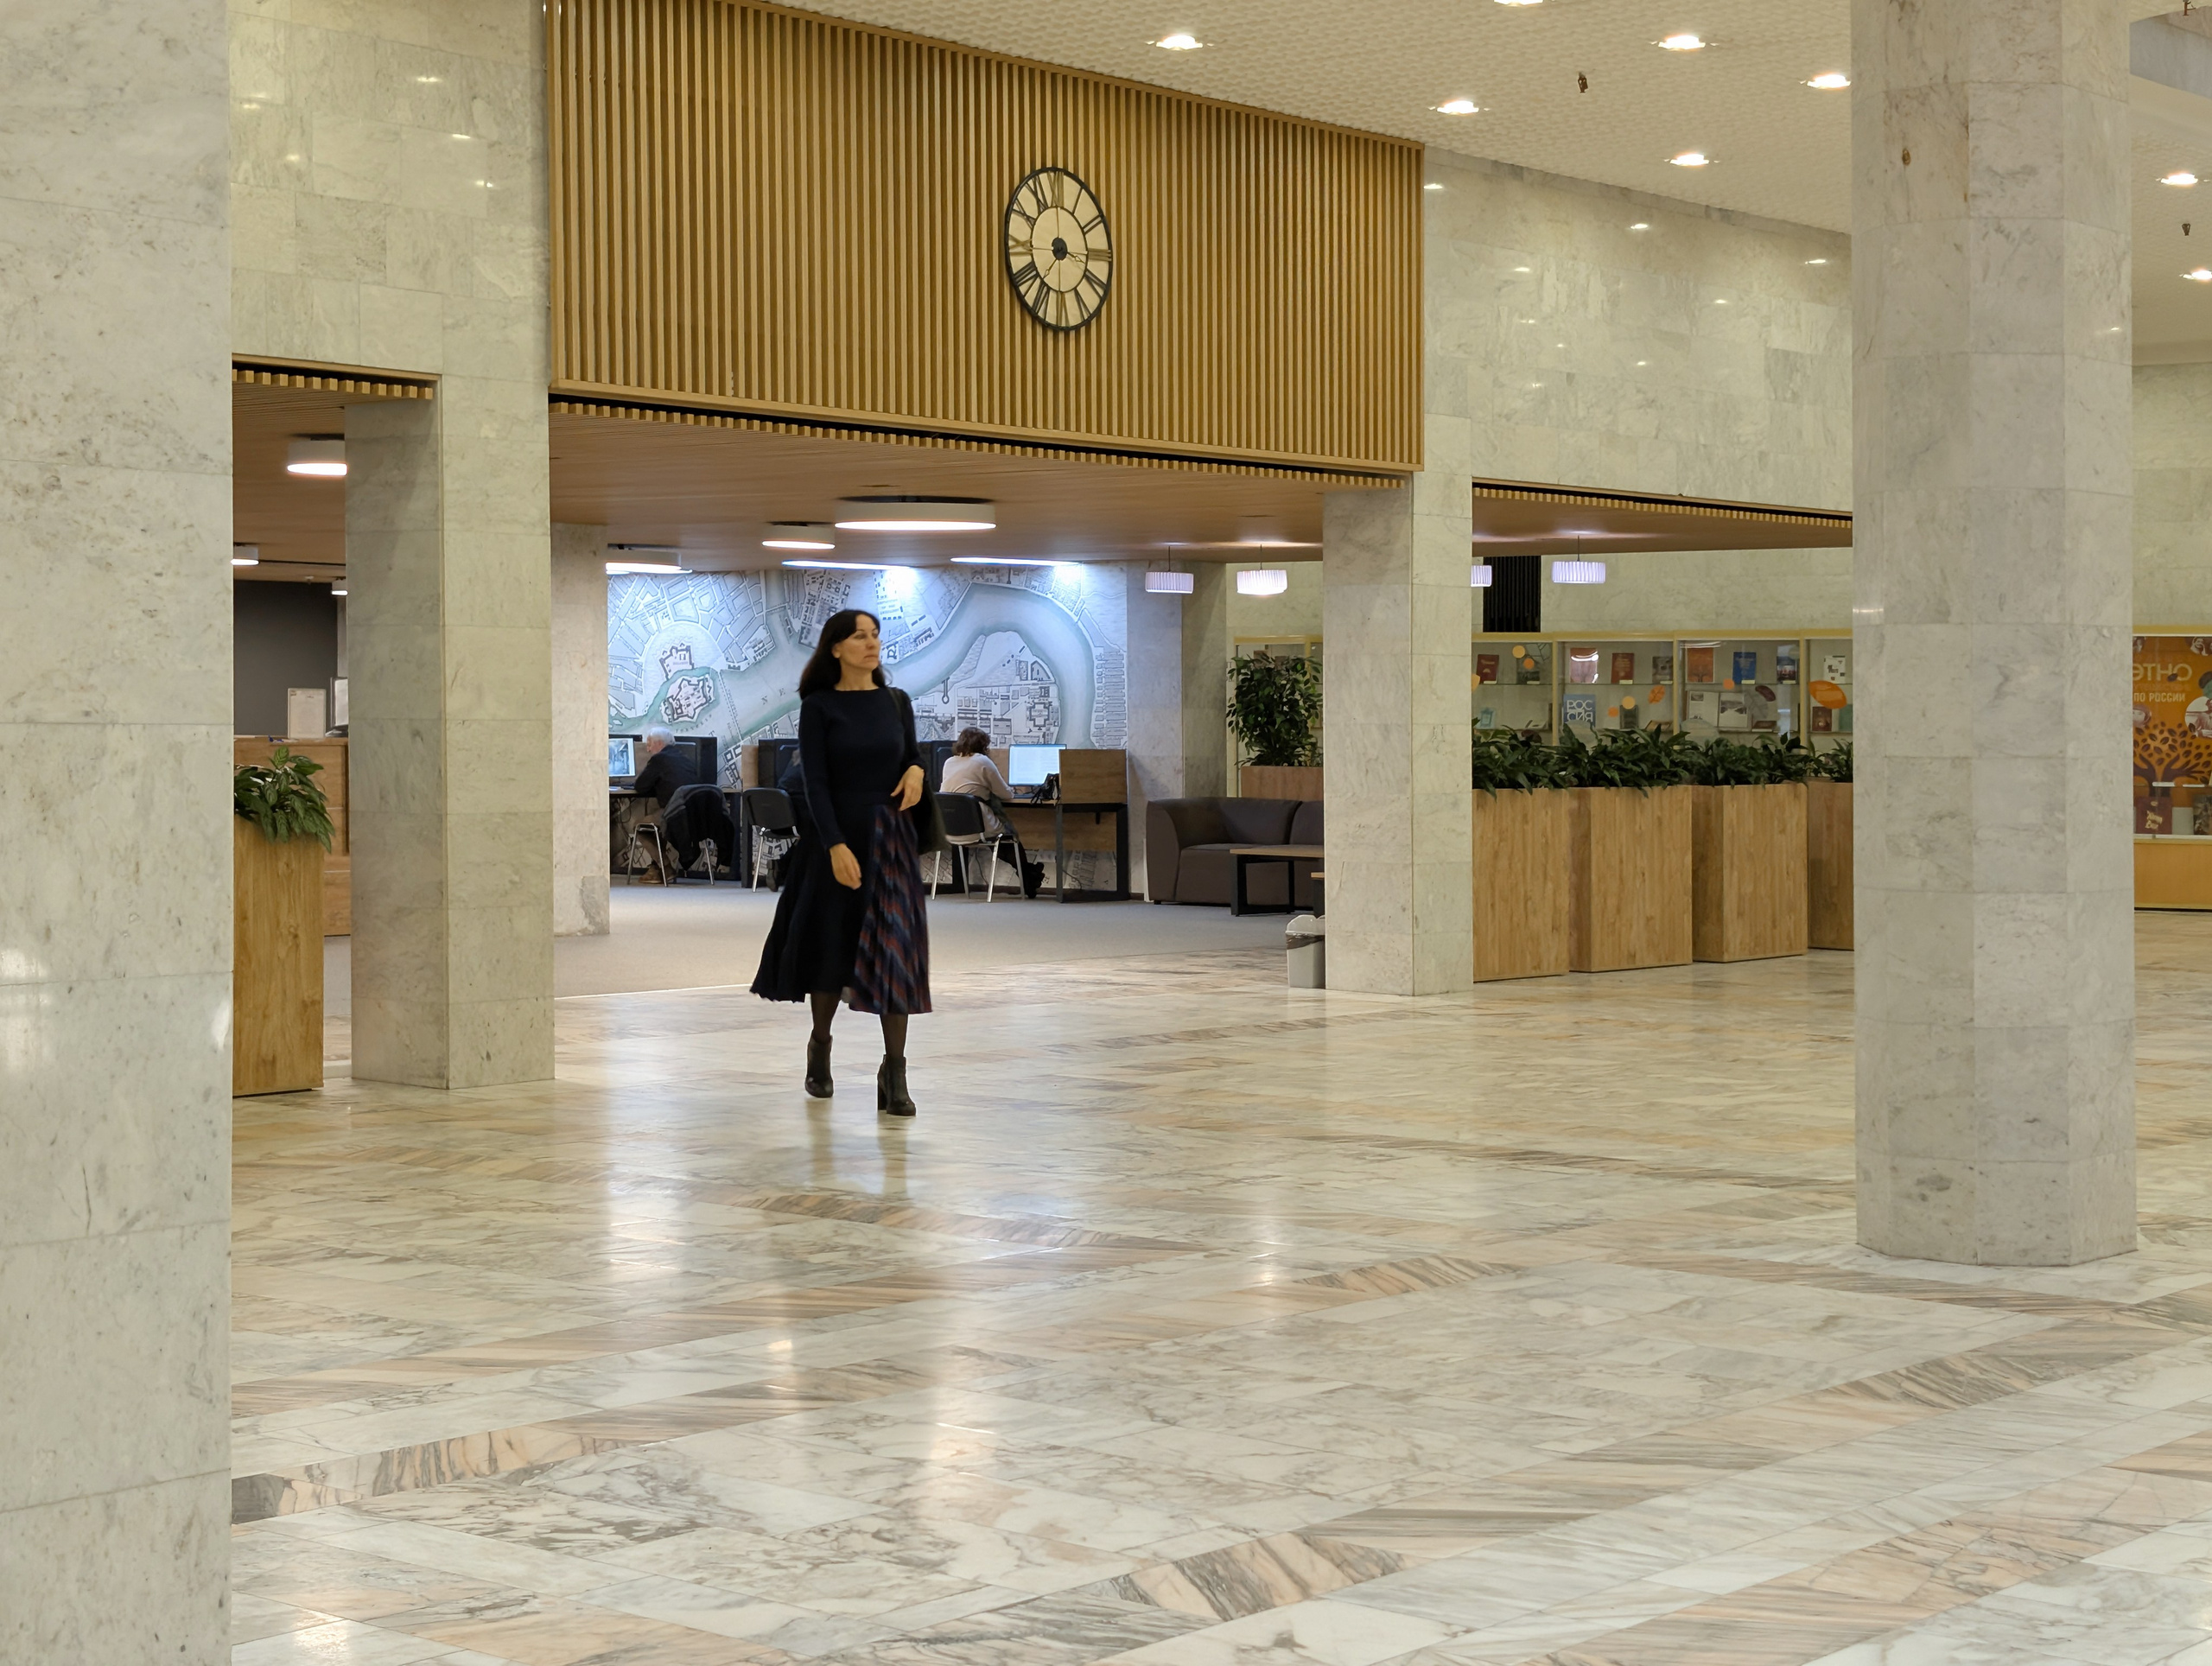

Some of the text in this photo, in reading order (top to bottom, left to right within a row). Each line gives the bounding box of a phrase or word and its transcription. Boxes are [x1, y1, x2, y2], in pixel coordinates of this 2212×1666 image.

[1081, 213, 1103, 235] II
[1087, 247, 1112, 262] III
[2133, 663, 2193, 681] ЭТНО
[2133, 692, 2186, 702] ПО РОССИИ
